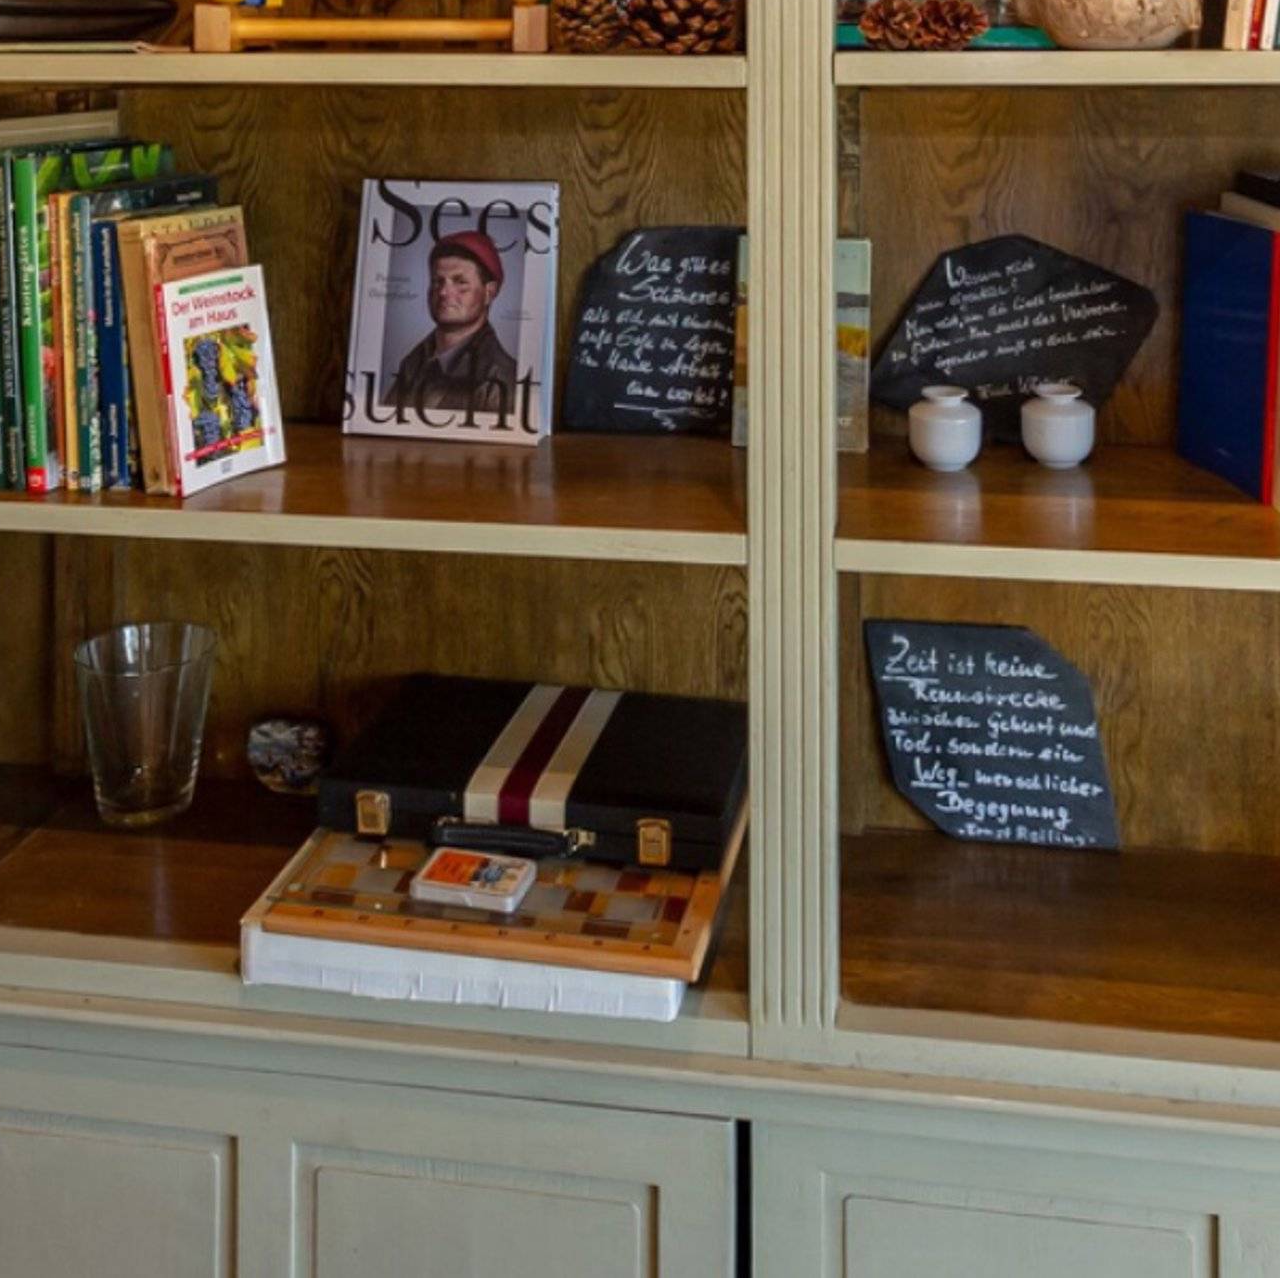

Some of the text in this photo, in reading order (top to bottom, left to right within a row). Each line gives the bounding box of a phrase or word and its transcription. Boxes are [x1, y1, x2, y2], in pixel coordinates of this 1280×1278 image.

[191, 283, 256, 313] Weinstock
[206, 310, 238, 324] Haus
[885, 634, 1057, 679] Zeit ist keine
[986, 711, 1054, 738] Geburt
[1059, 721, 1098, 739] und
[1038, 744, 1085, 763] ein
[914, 758, 1104, 798] Weg menschlicher
[936, 791, 1071, 829] Begegnung
